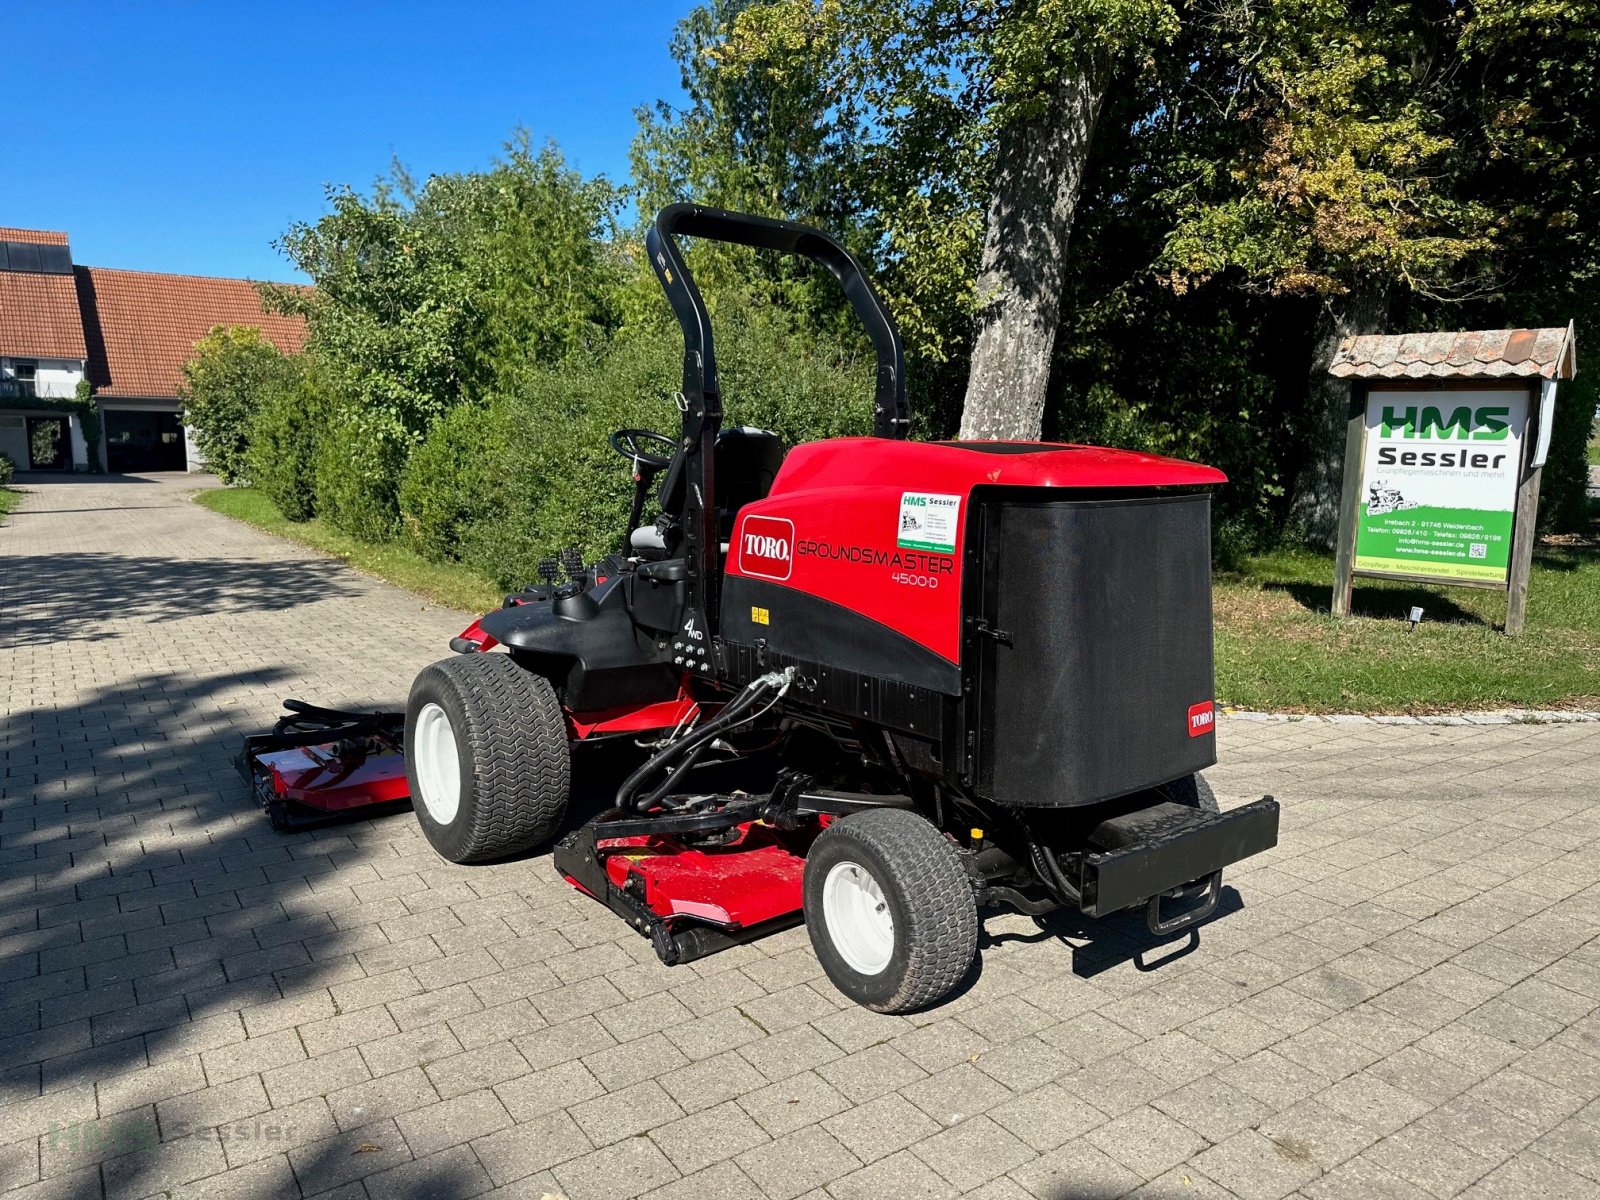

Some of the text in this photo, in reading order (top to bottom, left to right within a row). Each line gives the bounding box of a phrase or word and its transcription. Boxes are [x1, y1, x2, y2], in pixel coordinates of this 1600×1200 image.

[1380, 406, 1509, 440] HMS
[1377, 447, 1506, 468] Sessler
[903, 496, 957, 506] HMS Sessler
[796, 540, 954, 574] GROUNDSMASTER
[1191, 710, 1213, 728] TORO
